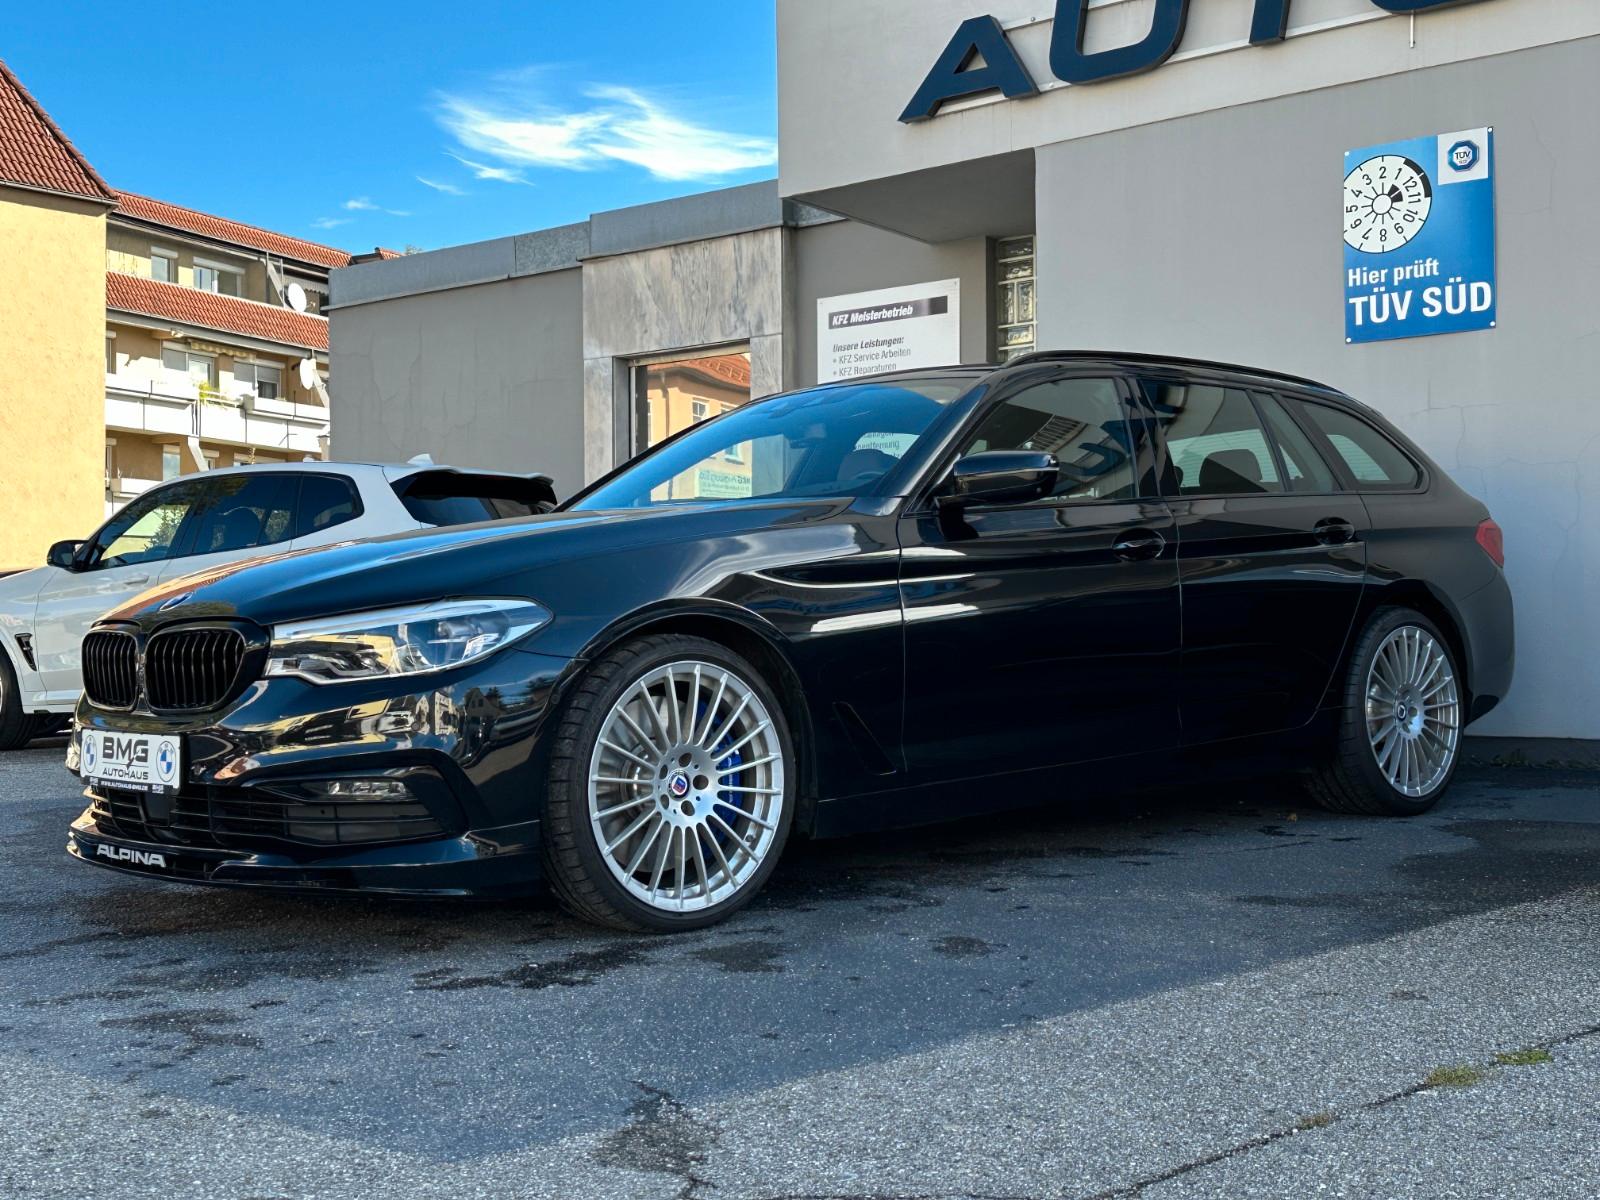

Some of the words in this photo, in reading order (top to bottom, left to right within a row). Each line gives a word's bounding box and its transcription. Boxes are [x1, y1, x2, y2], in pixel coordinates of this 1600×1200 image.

[1362, 174, 1372, 185] 3
[1379, 166, 1387, 179] 2
[1395, 167, 1402, 180] 1
[1403, 176, 1418, 192] 12
[1351, 189, 1363, 198] 4
[1408, 192, 1421, 203] 11
[1346, 205, 1358, 213] 5
[1403, 209, 1418, 223] 10
[1351, 218, 1362, 229] 6
[1394, 222, 1404, 234] 9
[1362, 228, 1372, 240] 7
[1380, 228, 1387, 242] 8
[1348, 267, 1388, 287] Hier
[1394, 258, 1440, 286] prüft
[1349, 287, 1412, 326] TÜV
[1422, 277, 1492, 318] SÜD
[832, 313, 849, 326] KFZ
[850, 305, 914, 323] Meisterbetrieb
[833, 343, 859, 352] Unsere
[860, 337, 905, 349] Leistungen:
[839, 354, 852, 364] KFZ
[854, 352, 880, 363] Service
[881, 348, 911, 359] Arbeiten
[839, 367, 852, 377] KFZ
[854, 363, 897, 376] Reparaturen
[102, 736, 149, 763] BMG
[102, 768, 149, 780] AUTOHAUS
[97, 843, 167, 868] ALPINA
